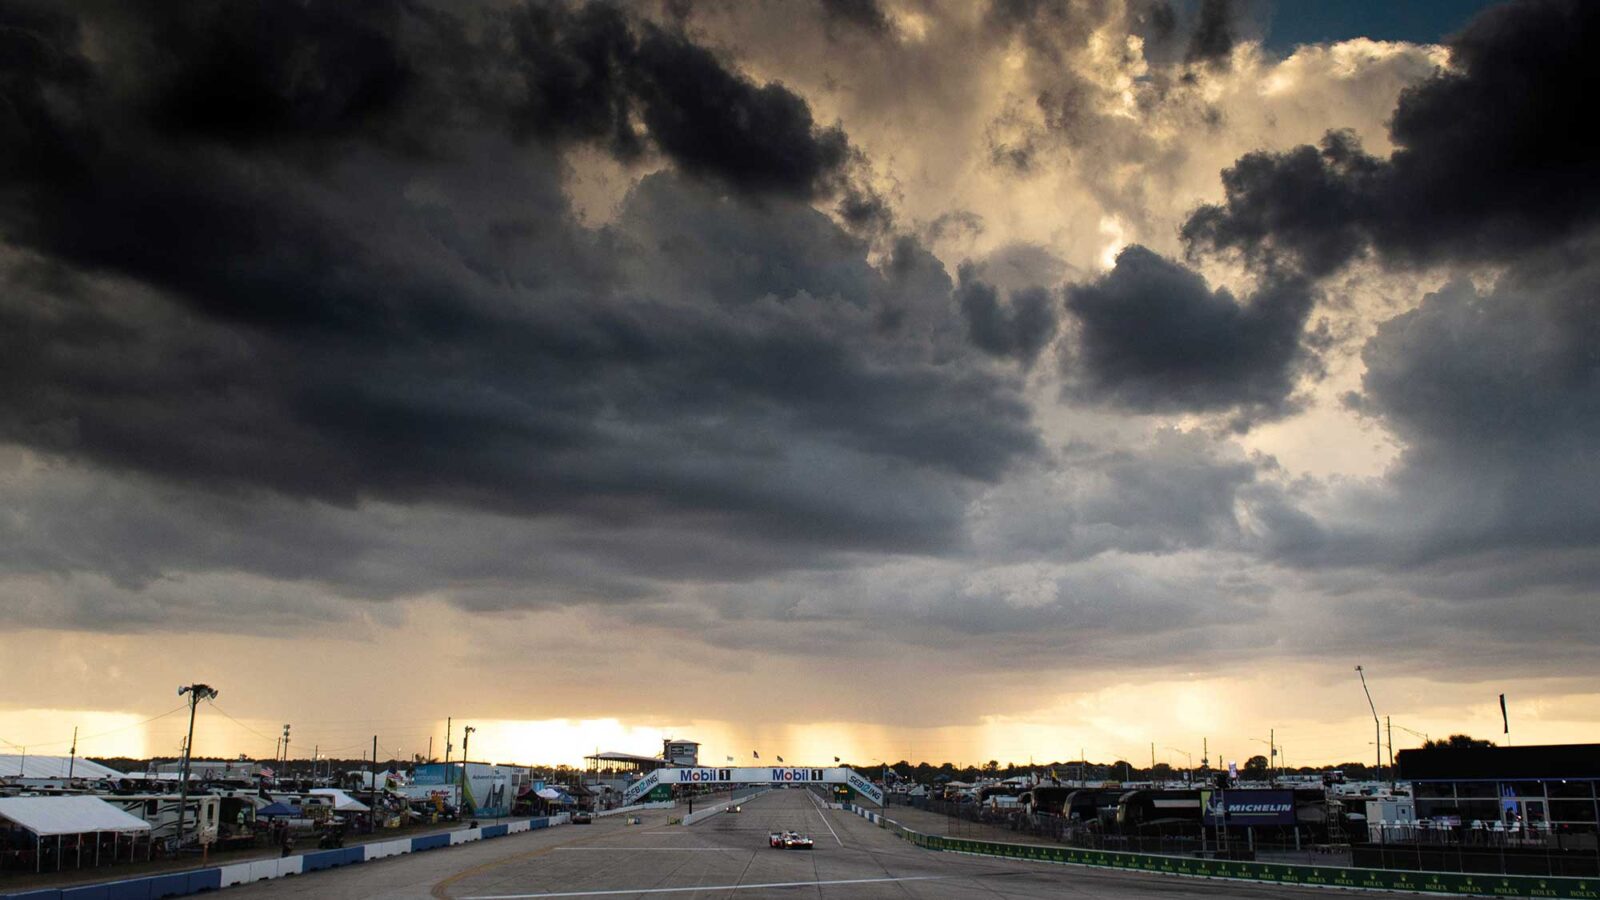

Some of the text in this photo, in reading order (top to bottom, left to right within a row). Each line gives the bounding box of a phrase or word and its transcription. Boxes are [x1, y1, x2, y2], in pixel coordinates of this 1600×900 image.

[680, 769, 716, 782] Mobil
[772, 769, 809, 781] Mobil
[431, 789, 449, 797] Ryder
[1228, 803, 1292, 812] MICHELIN
[1334, 878, 1354, 886] ROLEX
[1458, 885, 1482, 893] ROLEX
[1494, 887, 1520, 895] ROLEX
[1570, 890, 1598, 898] ROLEX
